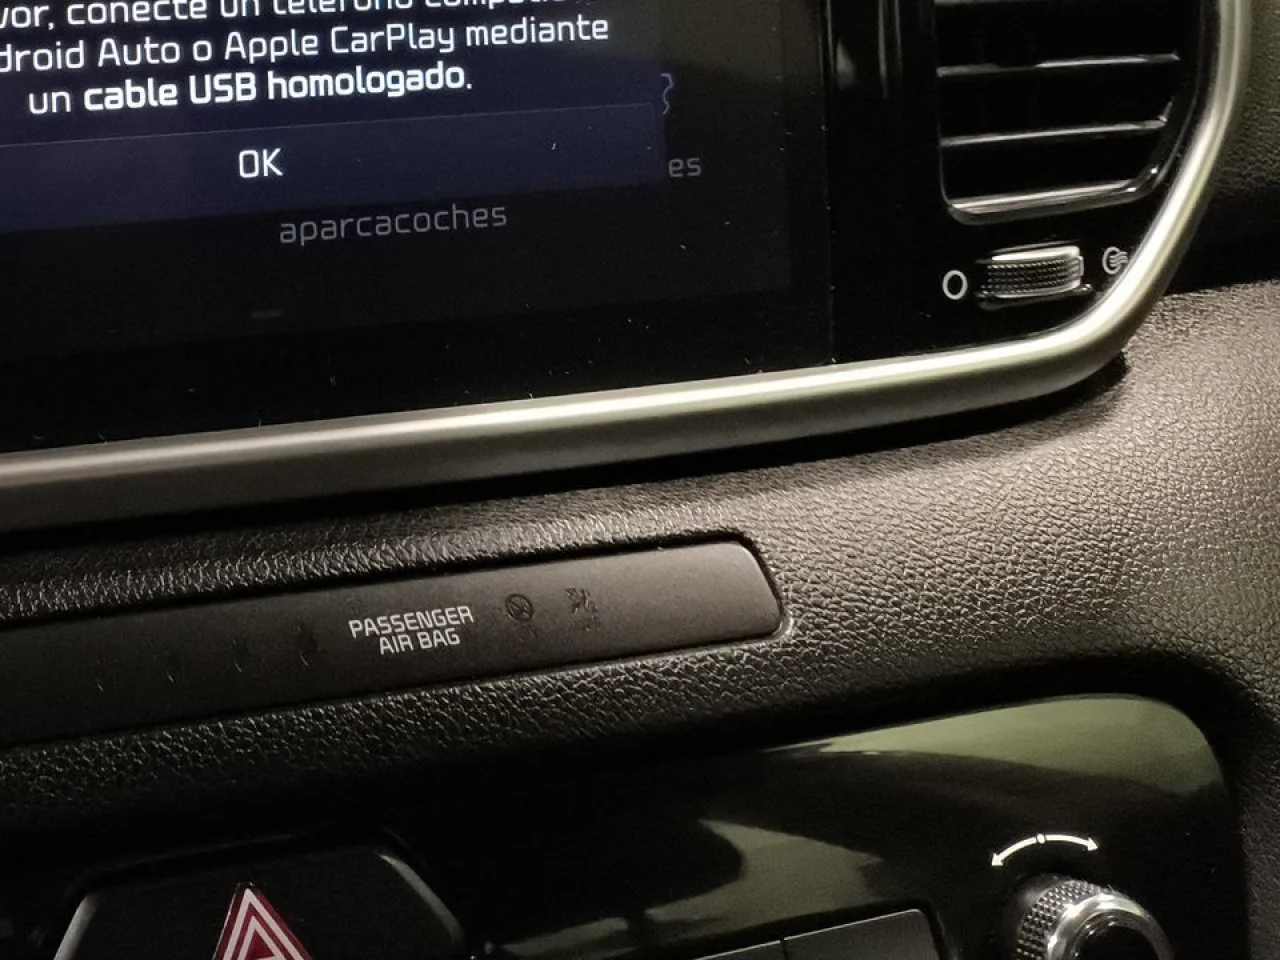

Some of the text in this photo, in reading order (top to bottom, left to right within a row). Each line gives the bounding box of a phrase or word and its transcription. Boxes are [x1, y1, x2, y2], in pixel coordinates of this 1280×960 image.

[97, 35, 181, 68] Auto
[191, 39, 213, 63] o
[224, 29, 319, 65] Apple
[330, 21, 455, 54] CarPlay
[465, 14, 609, 48] mediante
[28, 60, 473, 116] un cable USB homologado.
[238, 147, 284, 179] OK
[279, 202, 508, 246] aparcacoches
[348, 605, 475, 639] PASSENGER
[379, 627, 461, 656] AIR BAG
